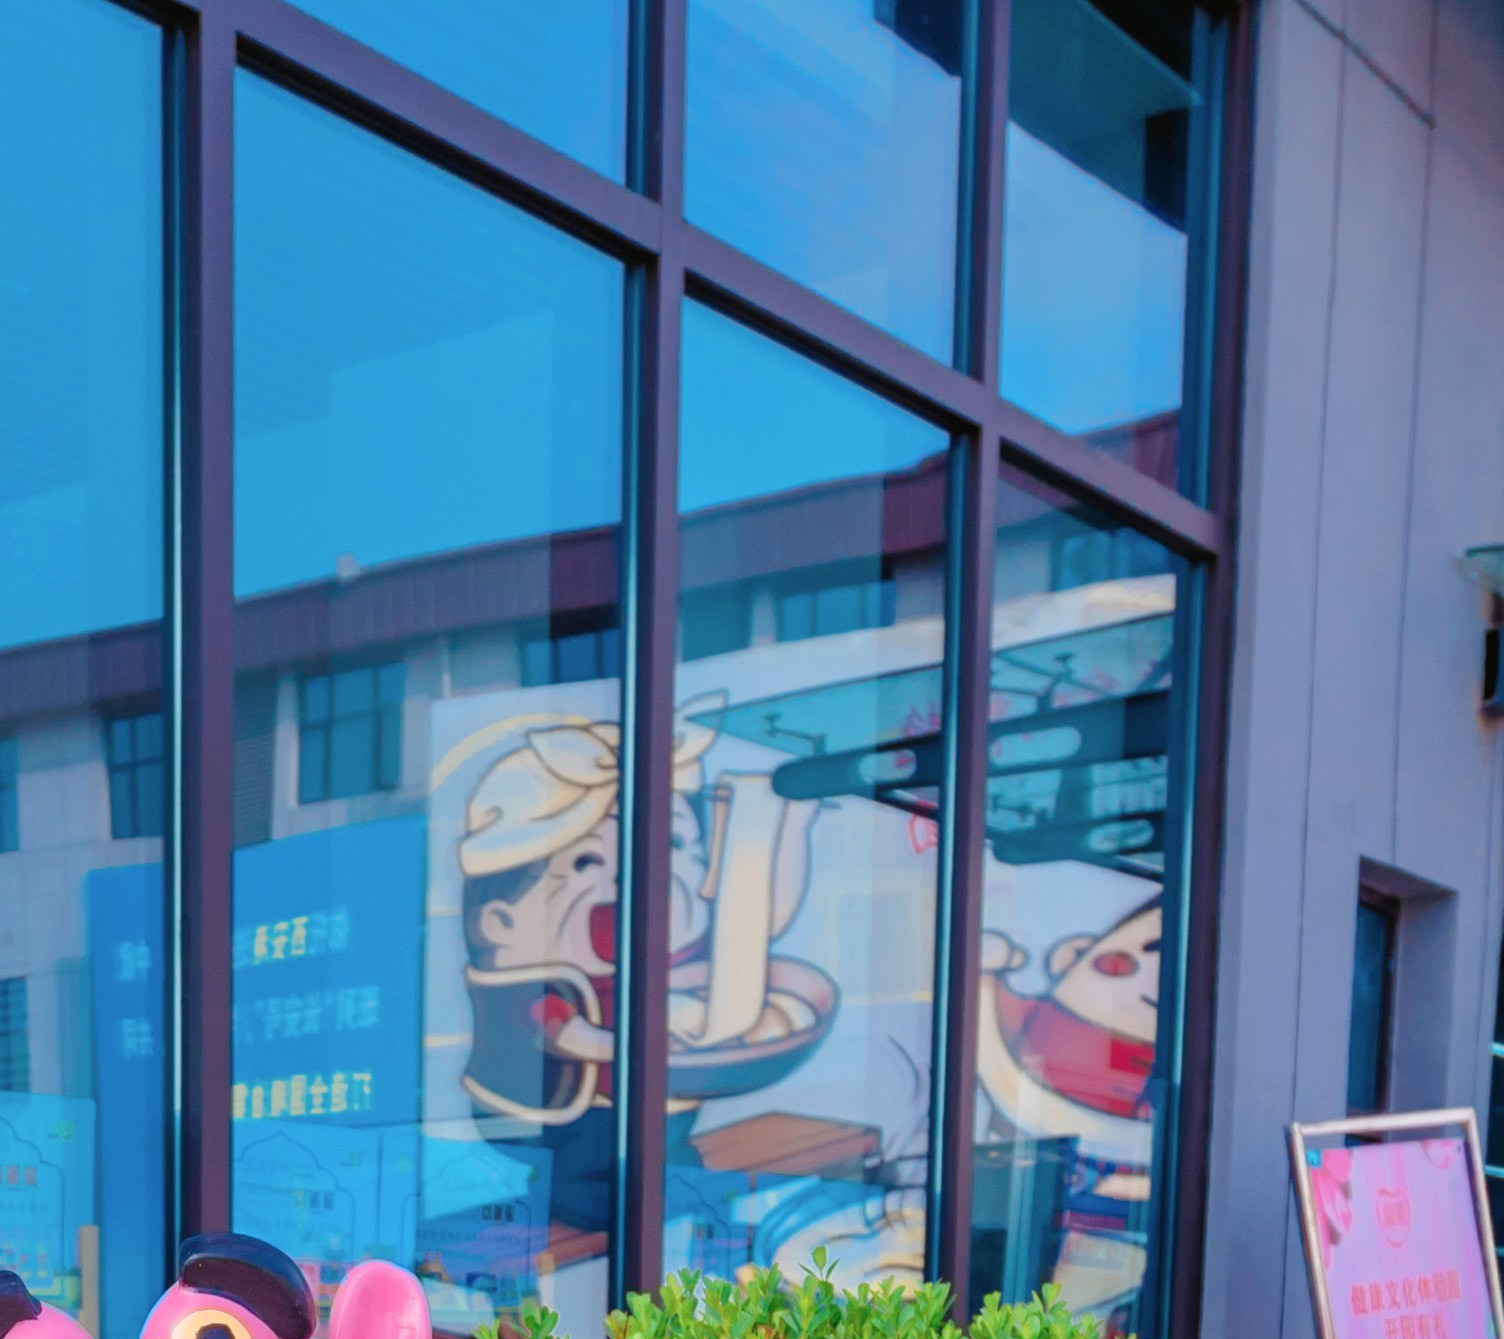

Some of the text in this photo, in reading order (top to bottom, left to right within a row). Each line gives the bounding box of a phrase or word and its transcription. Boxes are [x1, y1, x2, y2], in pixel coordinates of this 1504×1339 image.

[1351, 1269, 1460, 1316] 健康文化体验园
